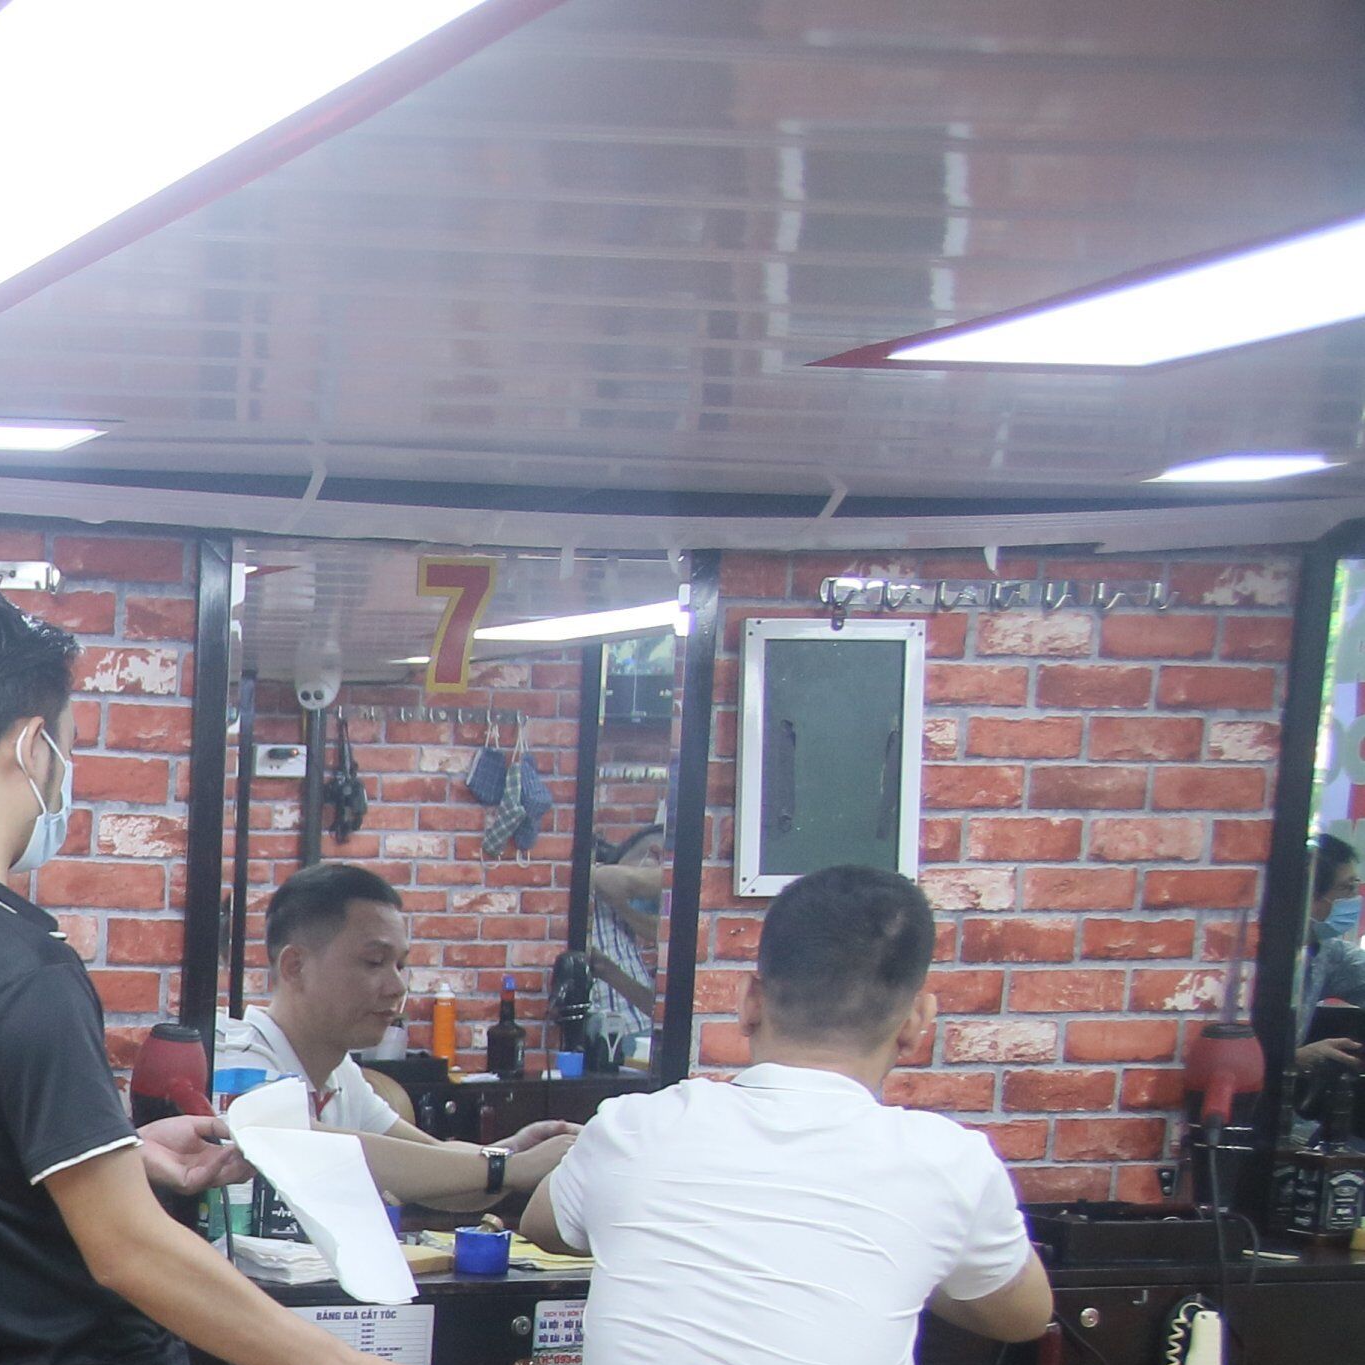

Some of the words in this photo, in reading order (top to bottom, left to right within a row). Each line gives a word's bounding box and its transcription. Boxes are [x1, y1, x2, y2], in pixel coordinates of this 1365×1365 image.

[417, 556, 498, 694] 7
[316, 1309, 341, 1321] BẢNG
[343, 1310, 358, 1320] GIÁ
[361, 1308, 377, 1320] CẮT
[380, 1309, 397, 1320] TÓC
